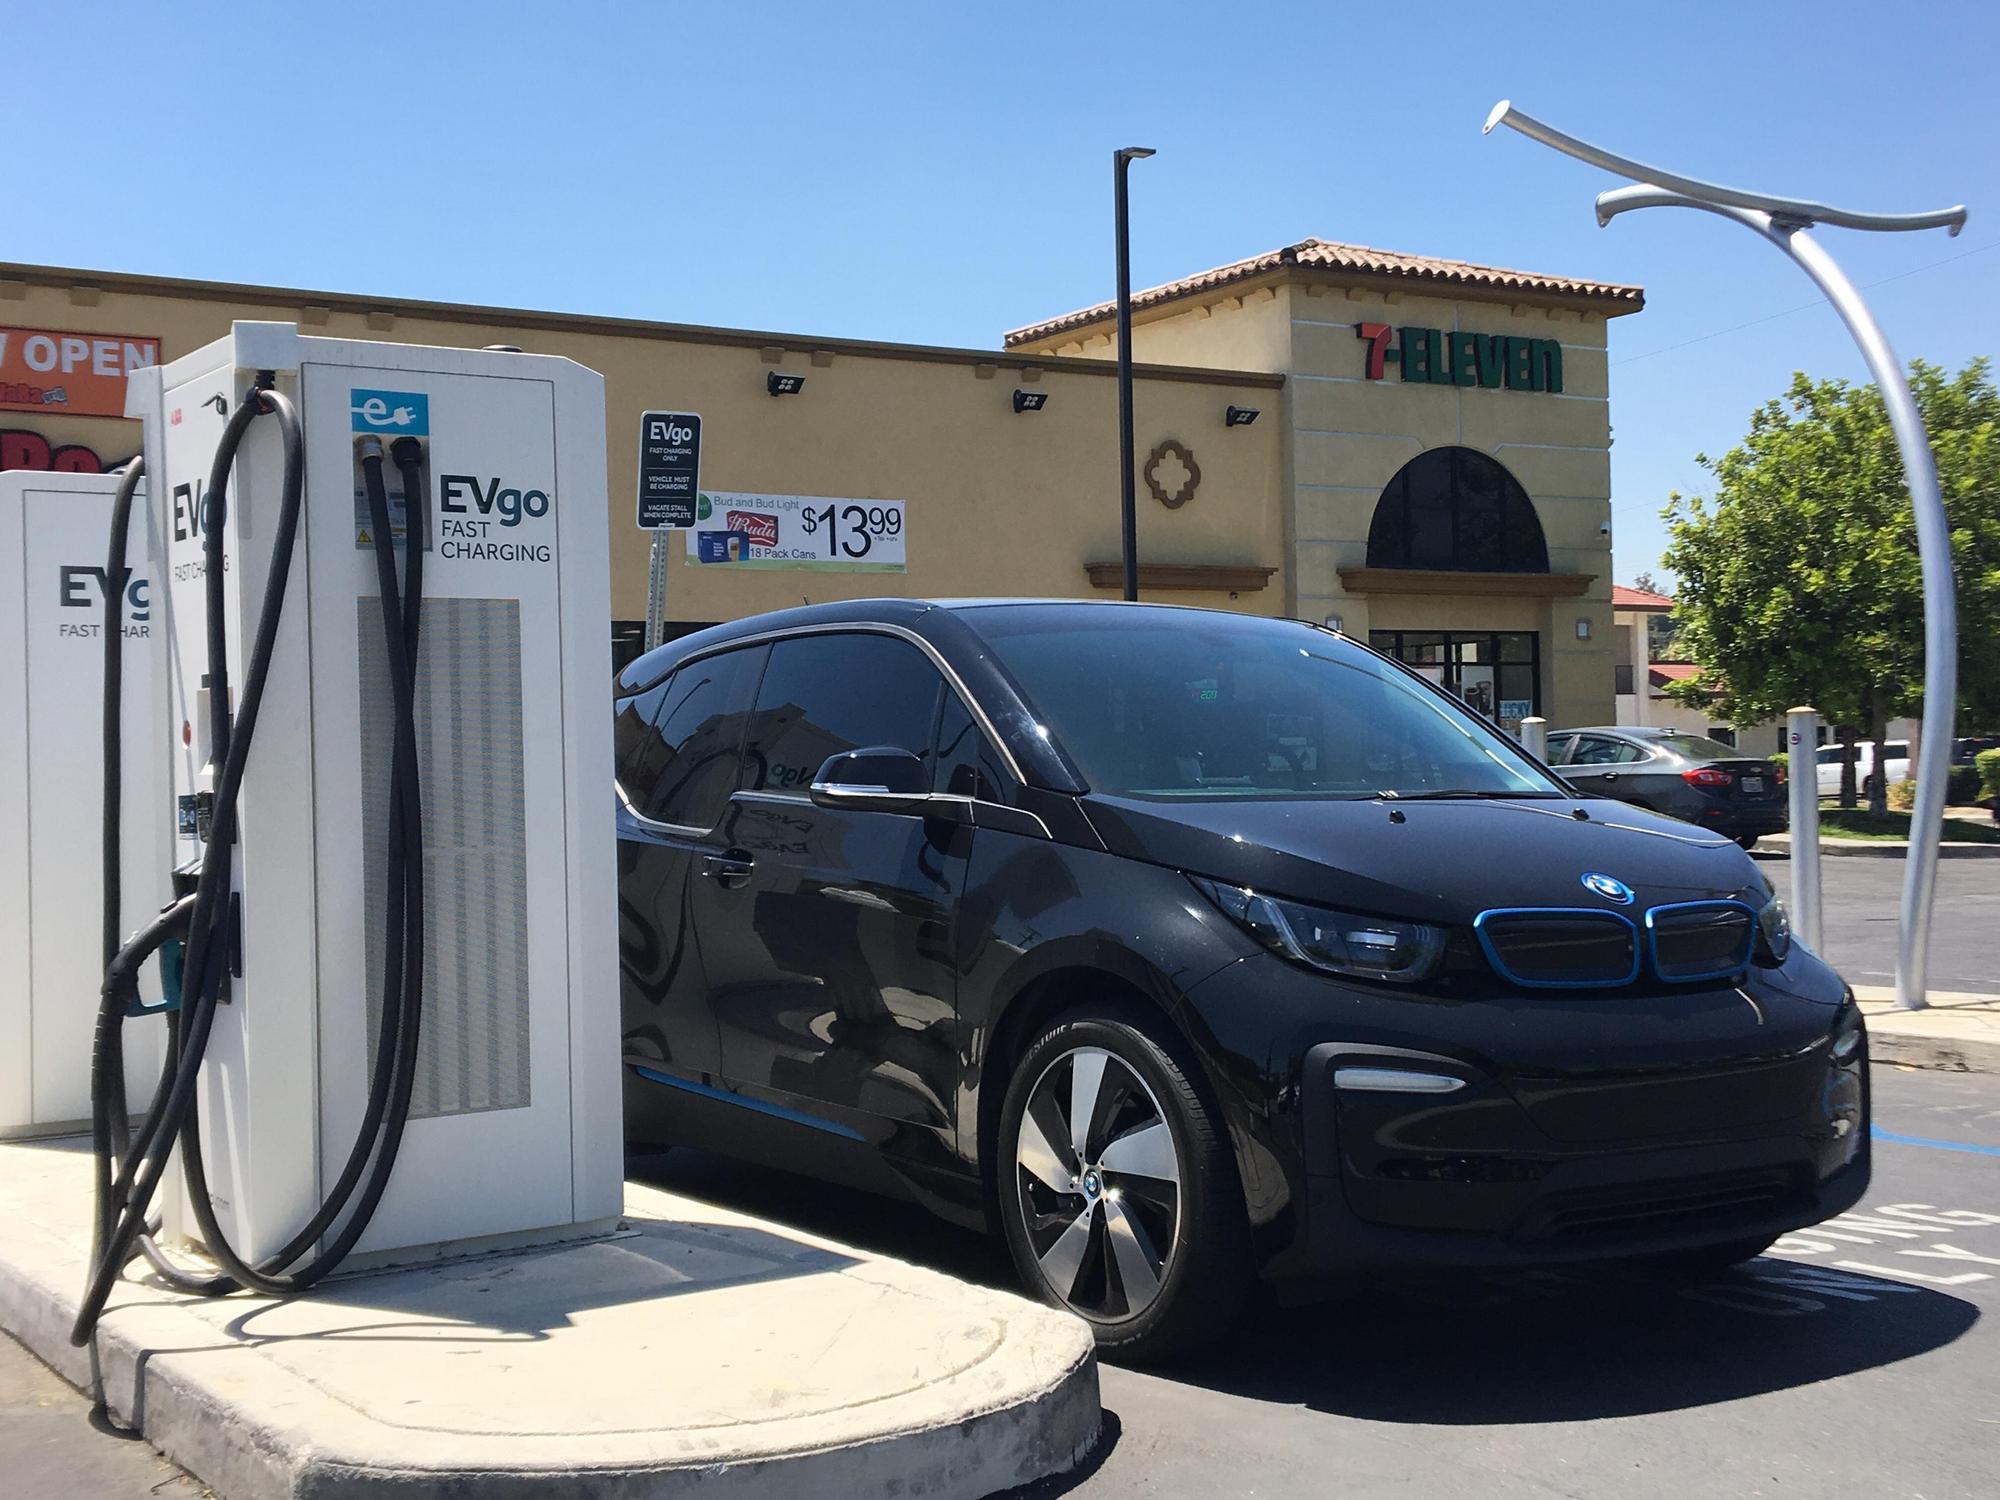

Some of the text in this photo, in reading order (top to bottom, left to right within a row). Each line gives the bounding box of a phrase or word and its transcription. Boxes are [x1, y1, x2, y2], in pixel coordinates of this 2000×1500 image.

[23, 335, 154, 377] OPEN
[650, 421, 692, 446] EVgo
[648, 475, 673, 483] VEHICLE
[440, 474, 549, 527] EVgo
[714, 496, 733, 506] Bud
[735, 498, 753, 508] and
[756, 499, 775, 508] Bud
[776, 500, 800, 511] Light
[441, 519, 491, 538] FAST
[441, 541, 551, 563] CHARGING
[750, 547, 816, 559] 18 Pack Cans
[59, 624, 100, 638] FAST
